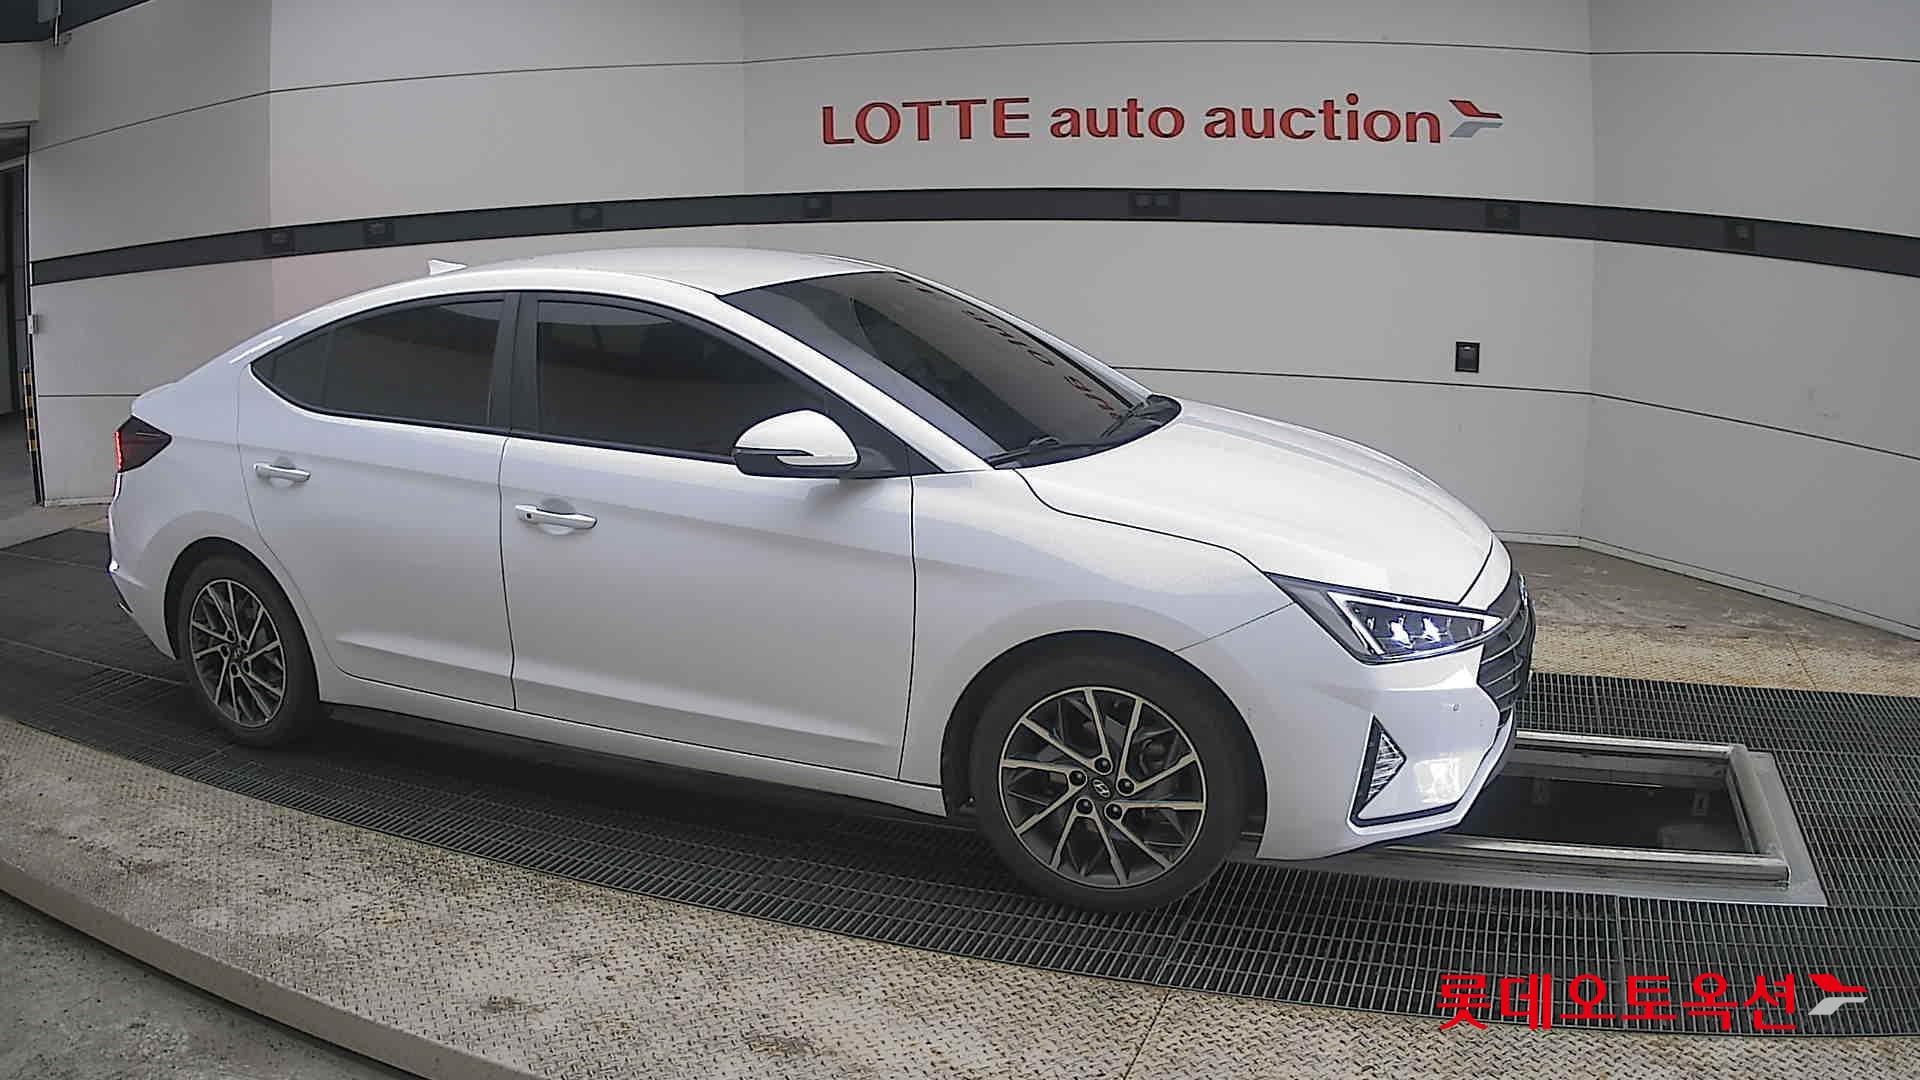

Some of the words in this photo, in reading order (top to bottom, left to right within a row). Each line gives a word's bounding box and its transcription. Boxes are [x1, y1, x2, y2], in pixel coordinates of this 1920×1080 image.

[821, 97, 1029, 146] LOTTE
[1049, 98, 1186, 139] auto
[1202, 93, 1442, 145] auction
